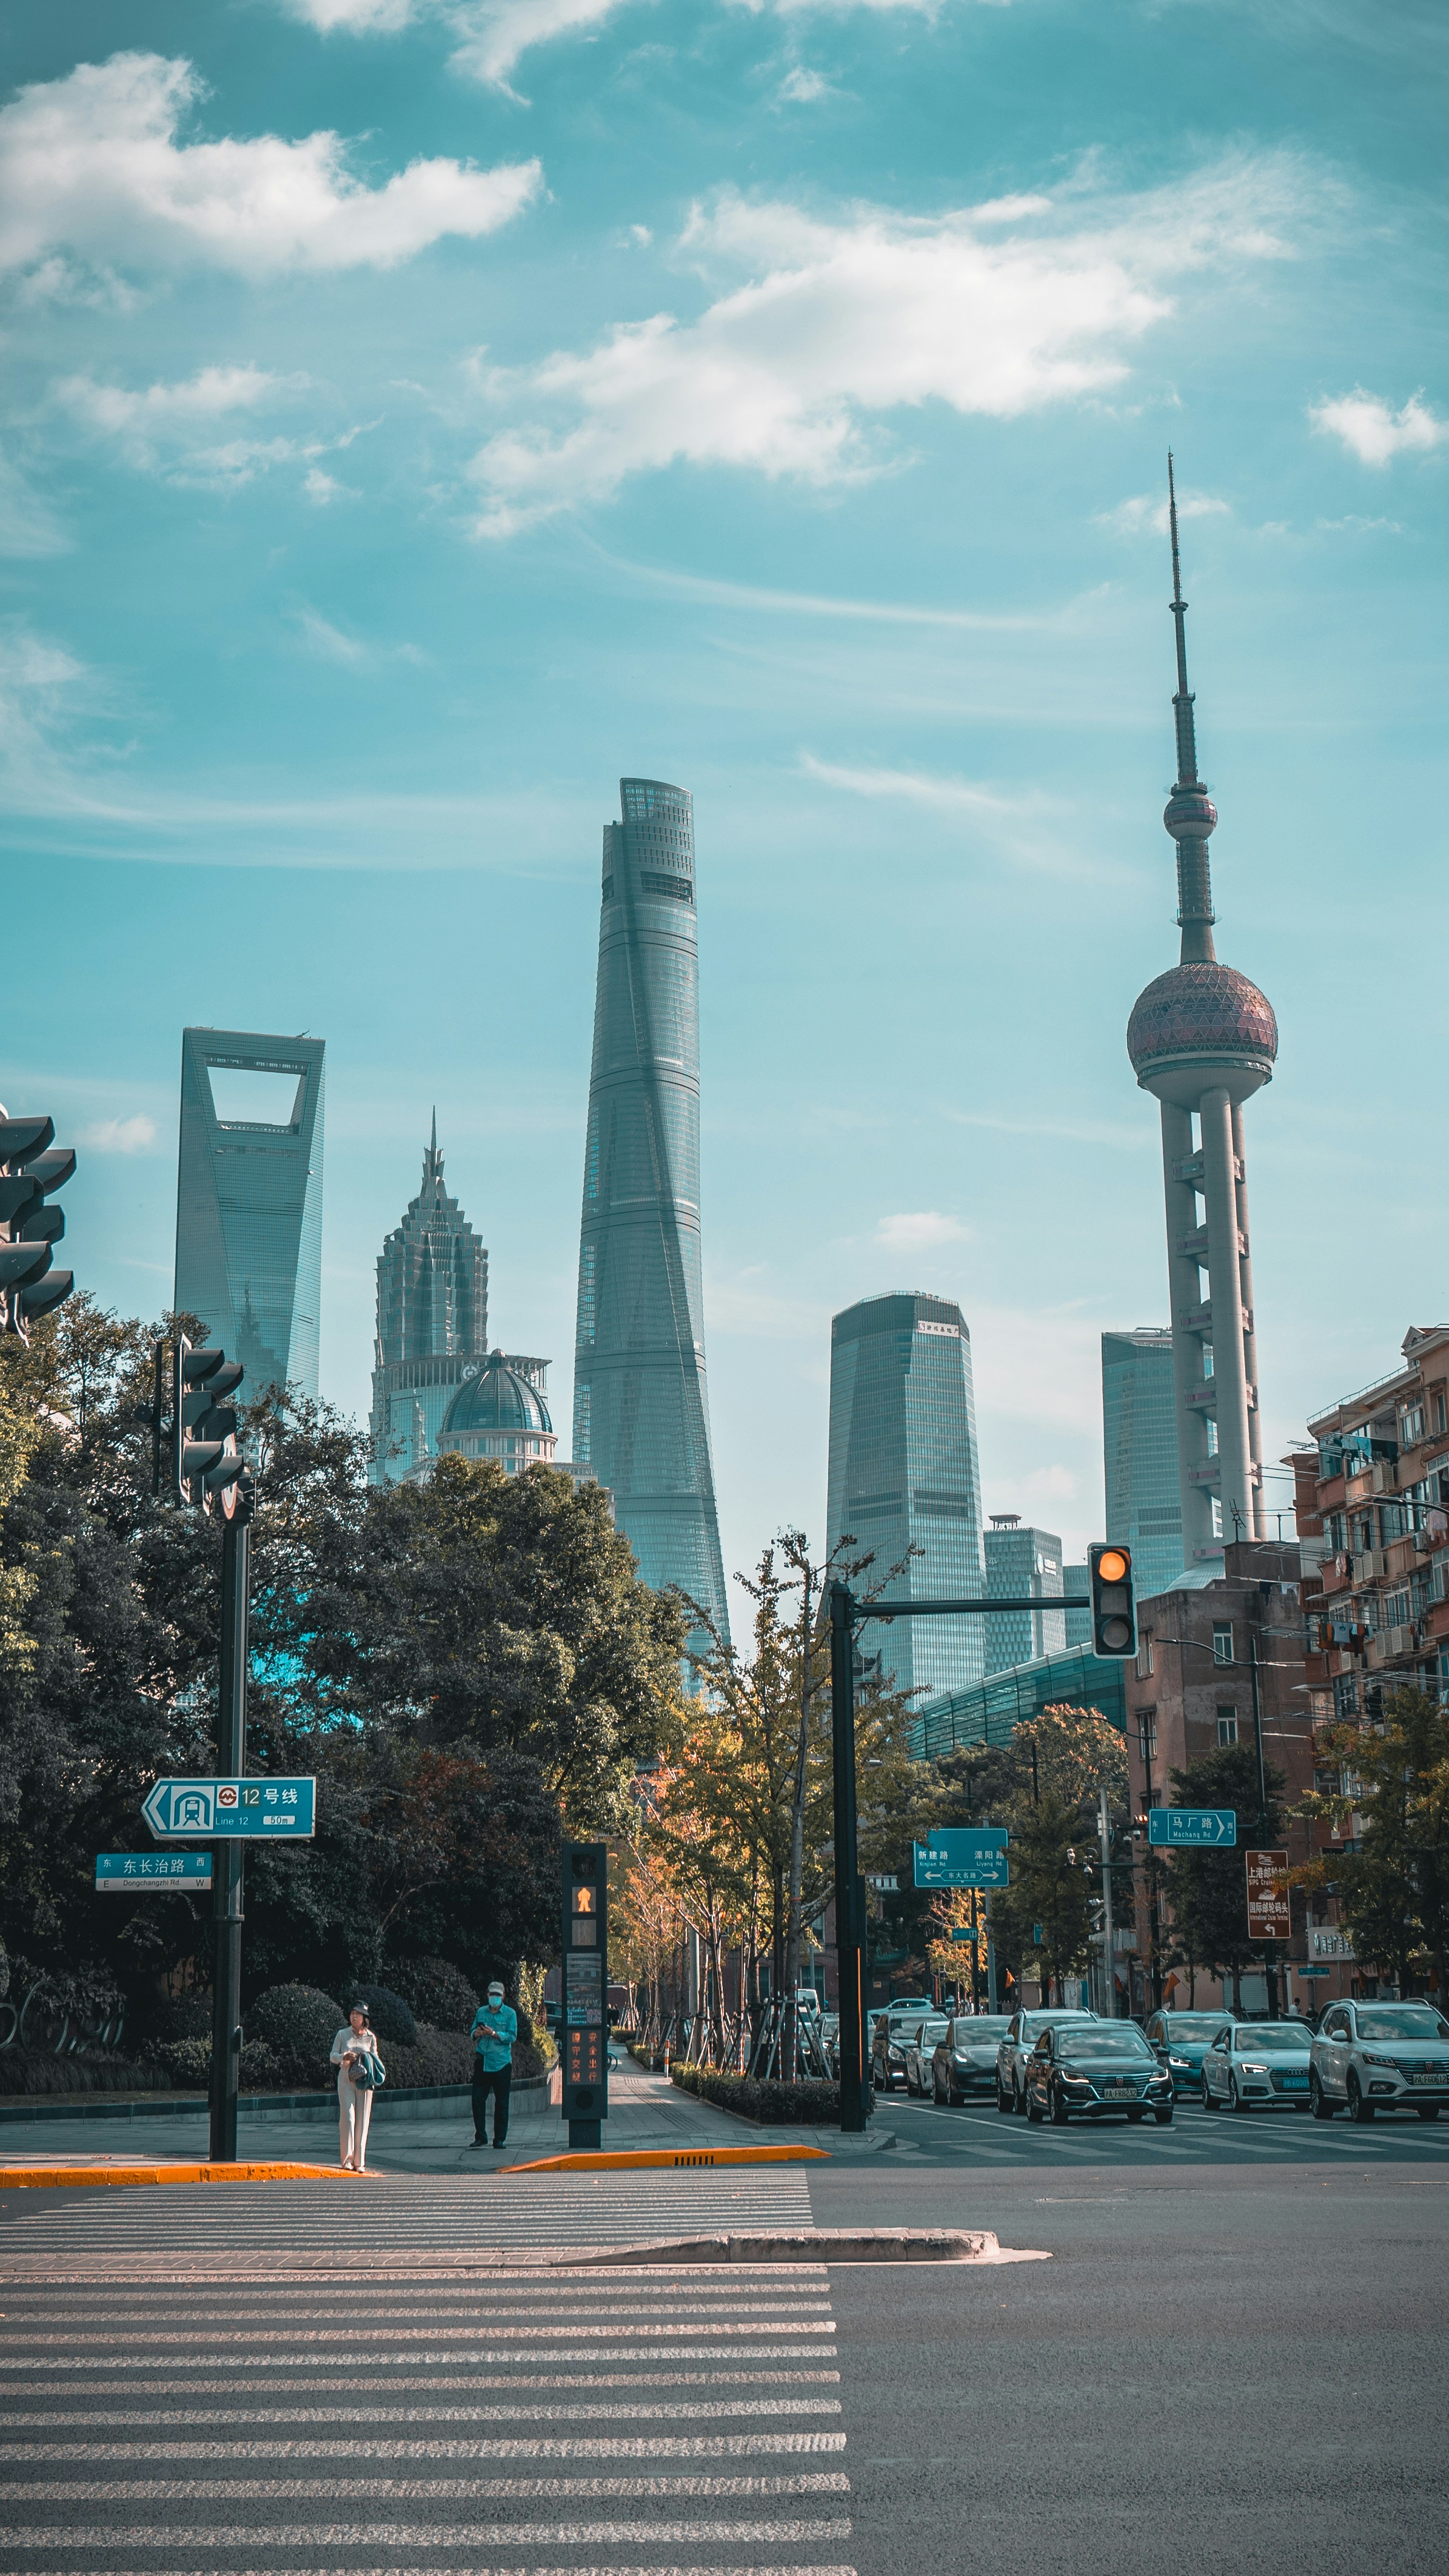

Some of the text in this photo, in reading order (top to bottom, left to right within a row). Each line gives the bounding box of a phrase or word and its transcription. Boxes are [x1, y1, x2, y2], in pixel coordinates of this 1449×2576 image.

[242, 1788, 298, 1805] 12号线
[215, 1817, 249, 1825] Line 12
[270, 1816, 288, 1825] 50m
[1173, 1817, 1212, 1829] 马厂路
[1173, 1831, 1200, 1839] Machang
[918, 1851, 948, 1860] 新建路
[104, 1858, 112, 1868] 东
[124, 1859, 184, 1874] 东长治路
[196, 1857, 205, 1867] 西
